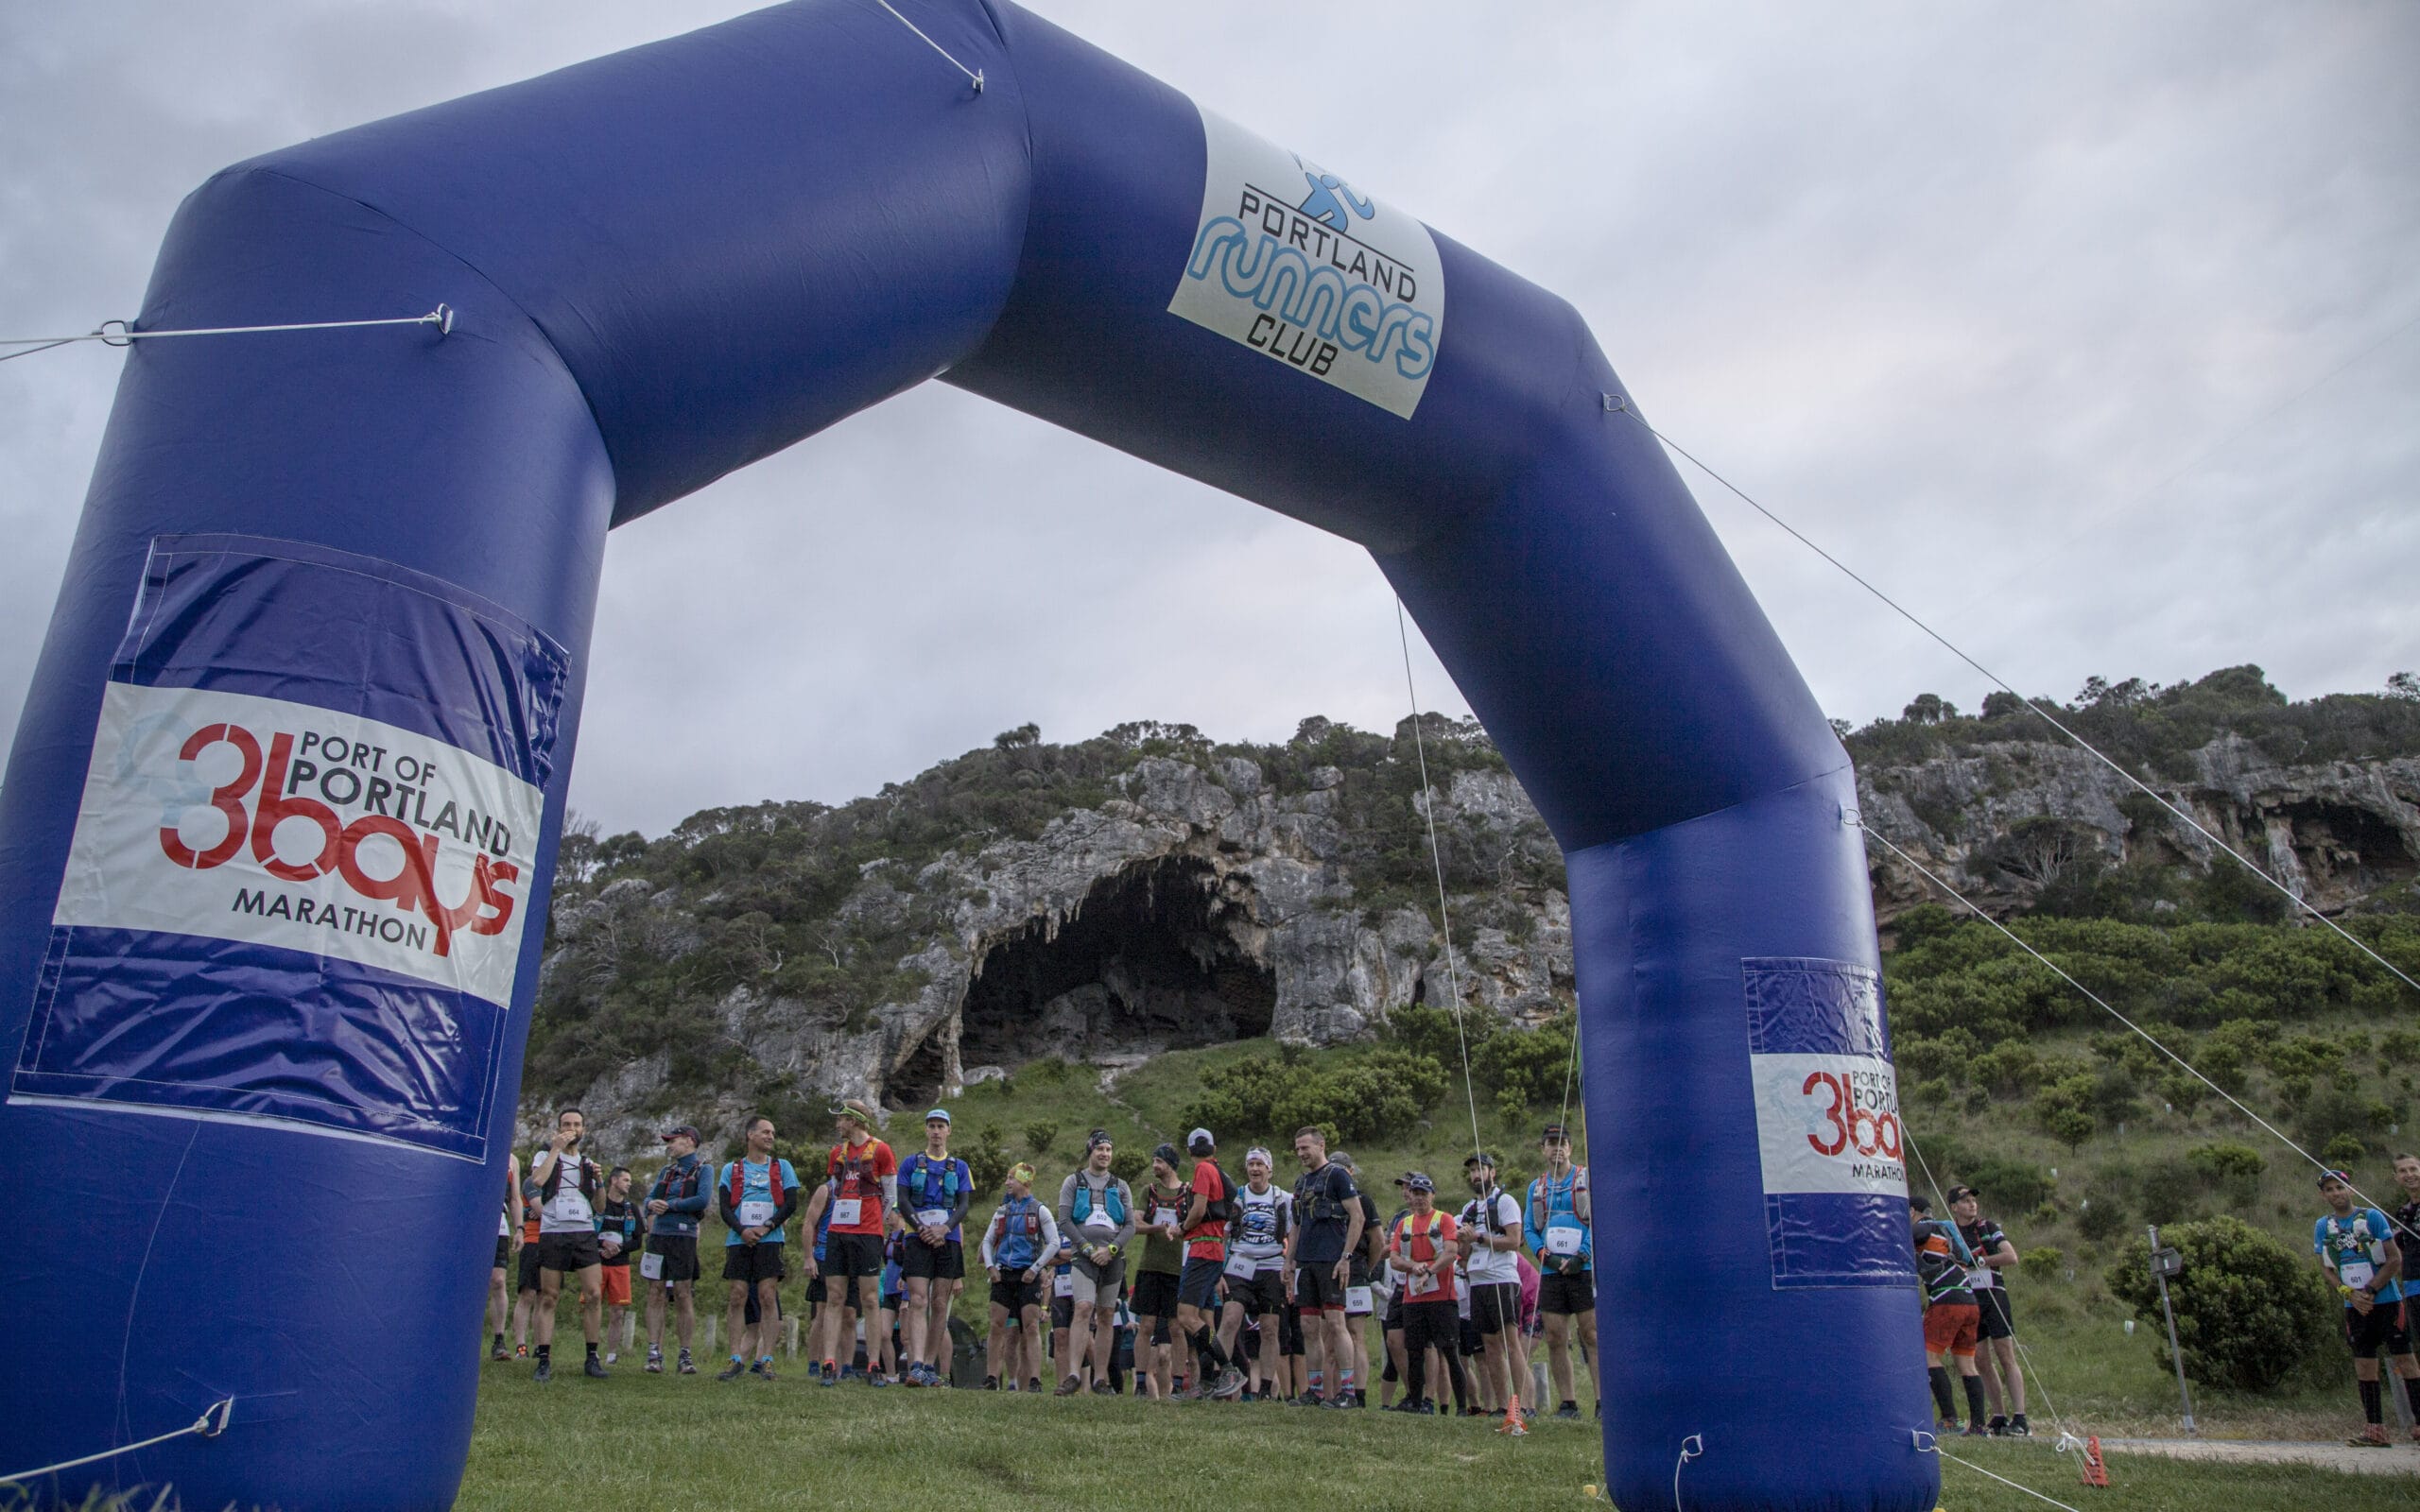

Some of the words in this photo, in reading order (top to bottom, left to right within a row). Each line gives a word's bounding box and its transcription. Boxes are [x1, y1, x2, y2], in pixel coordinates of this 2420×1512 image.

[1238, 190, 1416, 303] PORTLAND
[1187, 216, 1434, 380] runners
[1247, 313, 1339, 376] CLUB
[301, 730, 387, 773] PORT
[395, 756, 436, 787] OF
[287, 759, 511, 857] PORTLAND
[233, 888, 426, 951] MARATHON
[1852, 1070, 1879, 1089] PORT
[1556, 1240, 1568, 1248] 661
